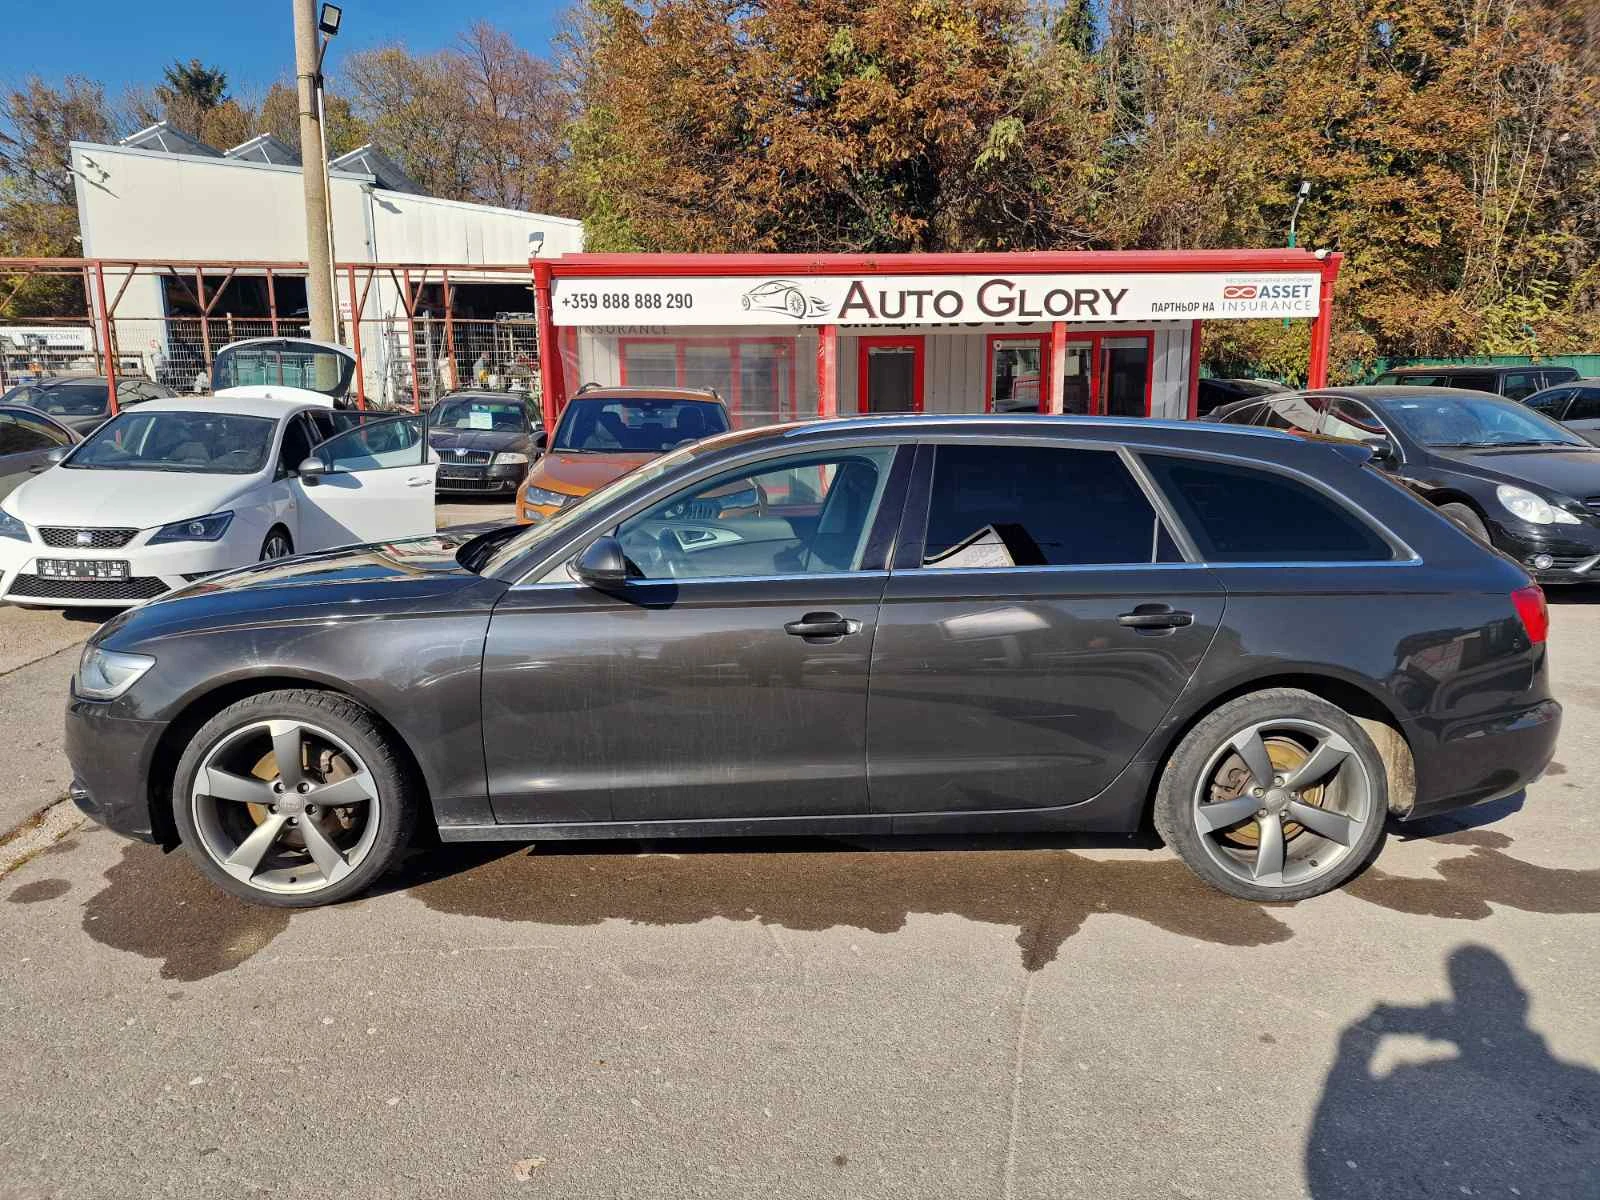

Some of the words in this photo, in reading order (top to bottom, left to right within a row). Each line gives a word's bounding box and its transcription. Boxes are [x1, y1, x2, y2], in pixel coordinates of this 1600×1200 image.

[1258, 284, 1313, 299] ASSET
[561, 293, 598, 309] +359
[602, 293, 630, 309] 888
[634, 293, 662, 309] 888
[666, 293, 693, 309] 290
[1151, 302, 1200, 313] ПАРТНЬОР
[1202, 302, 1215, 312] НА
[1222, 300, 1313, 312] INSURANCE
